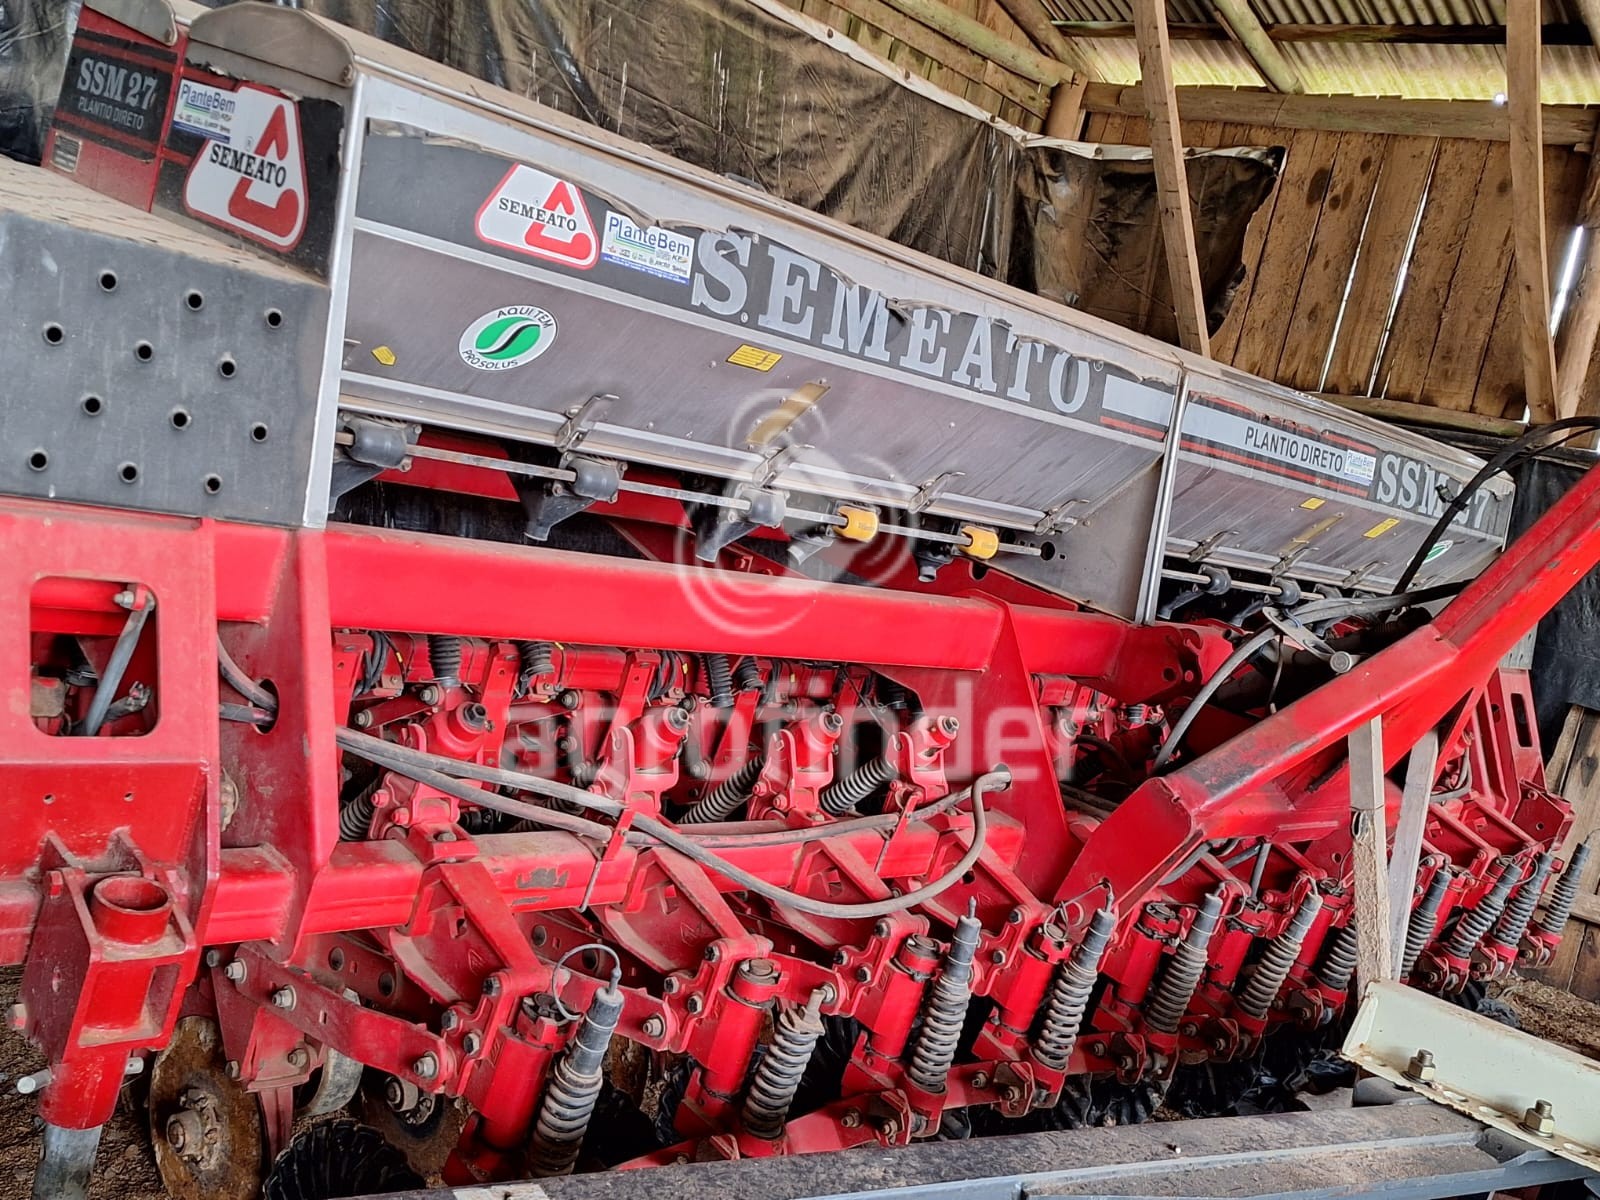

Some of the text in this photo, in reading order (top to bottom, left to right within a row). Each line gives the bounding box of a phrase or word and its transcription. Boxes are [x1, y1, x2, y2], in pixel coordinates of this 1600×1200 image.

[77, 58, 158, 110] SSM 27
[181, 84, 236, 114] PlanteBem
[78, 96, 145, 130] PLANTIO DIRETO
[210, 143, 287, 188] SEMEATO
[499, 197, 577, 232] SEMEATO
[608, 216, 690, 257] PlanteBem
[497, 307, 554, 329] AQUI TEM
[691, 230, 1090, 414] SEMEATO
[1245, 426, 1343, 473] PLANTIO DIRETO
[1376, 453, 1450, 518] SSM
